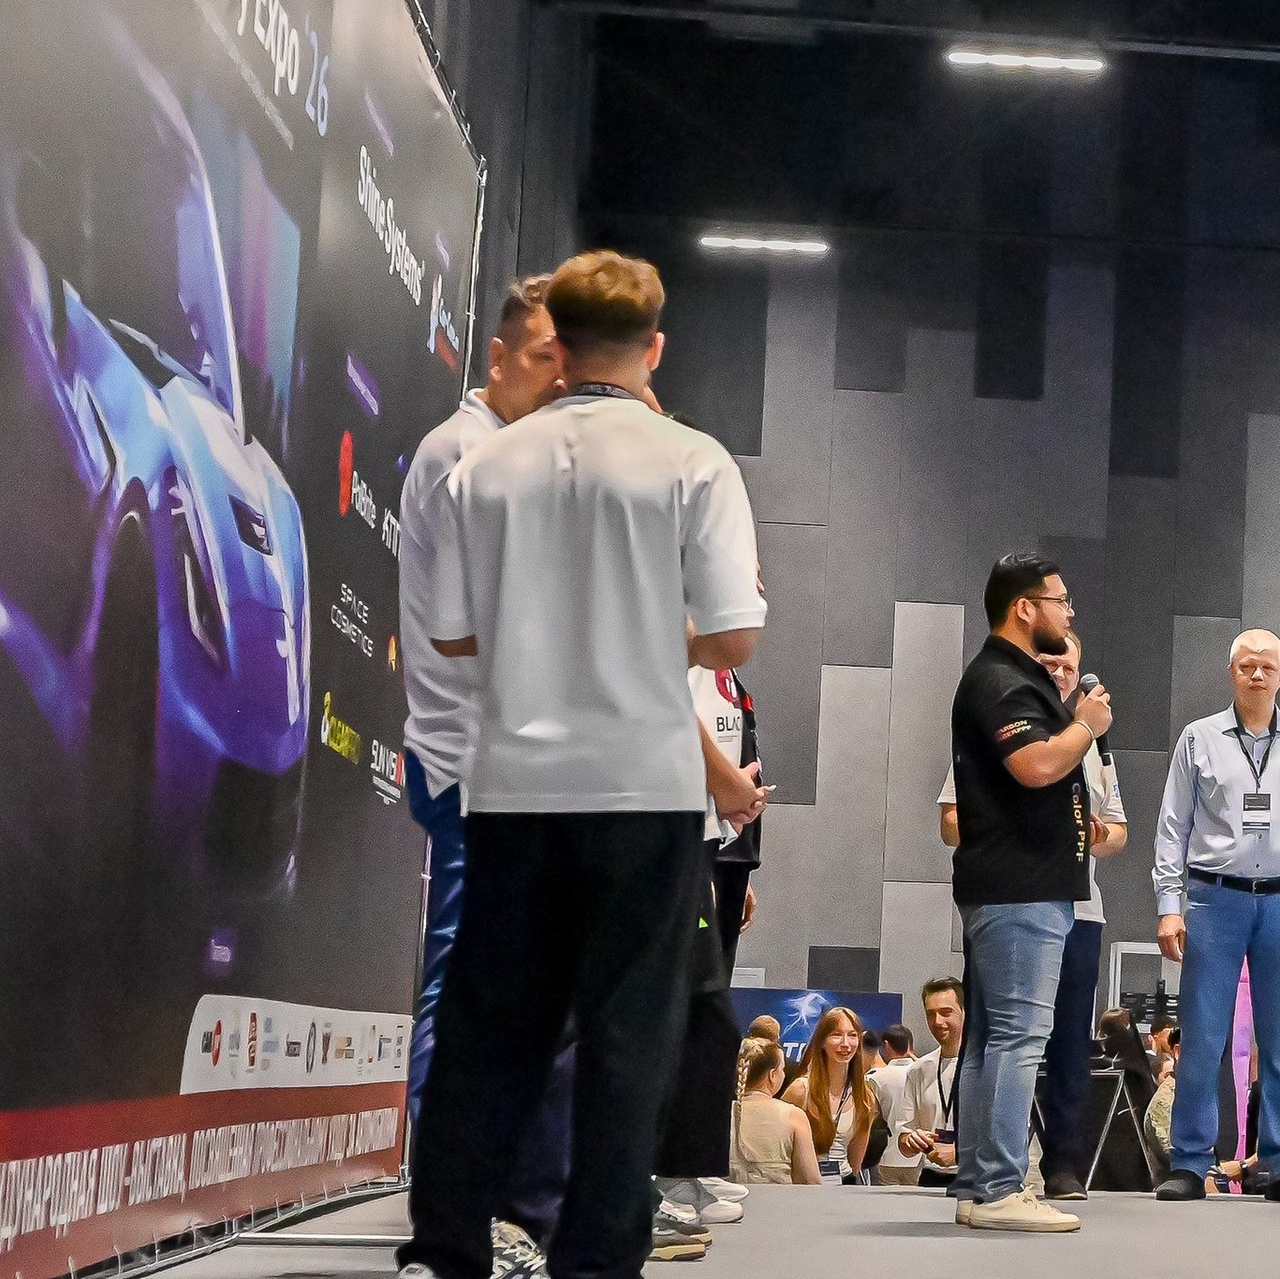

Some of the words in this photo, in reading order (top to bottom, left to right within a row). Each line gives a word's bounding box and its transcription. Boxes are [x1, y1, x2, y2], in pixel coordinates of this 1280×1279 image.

[357, 144, 386, 242] Shine
[340, 582, 370, 625] SPACE
[331, 604, 375, 658] COSMETICS
[1072, 782, 1084, 827] Color
[1075, 830, 1086, 863] PPF
[0, 1148, 98, 1253] ДУНАРОДНАЯ
